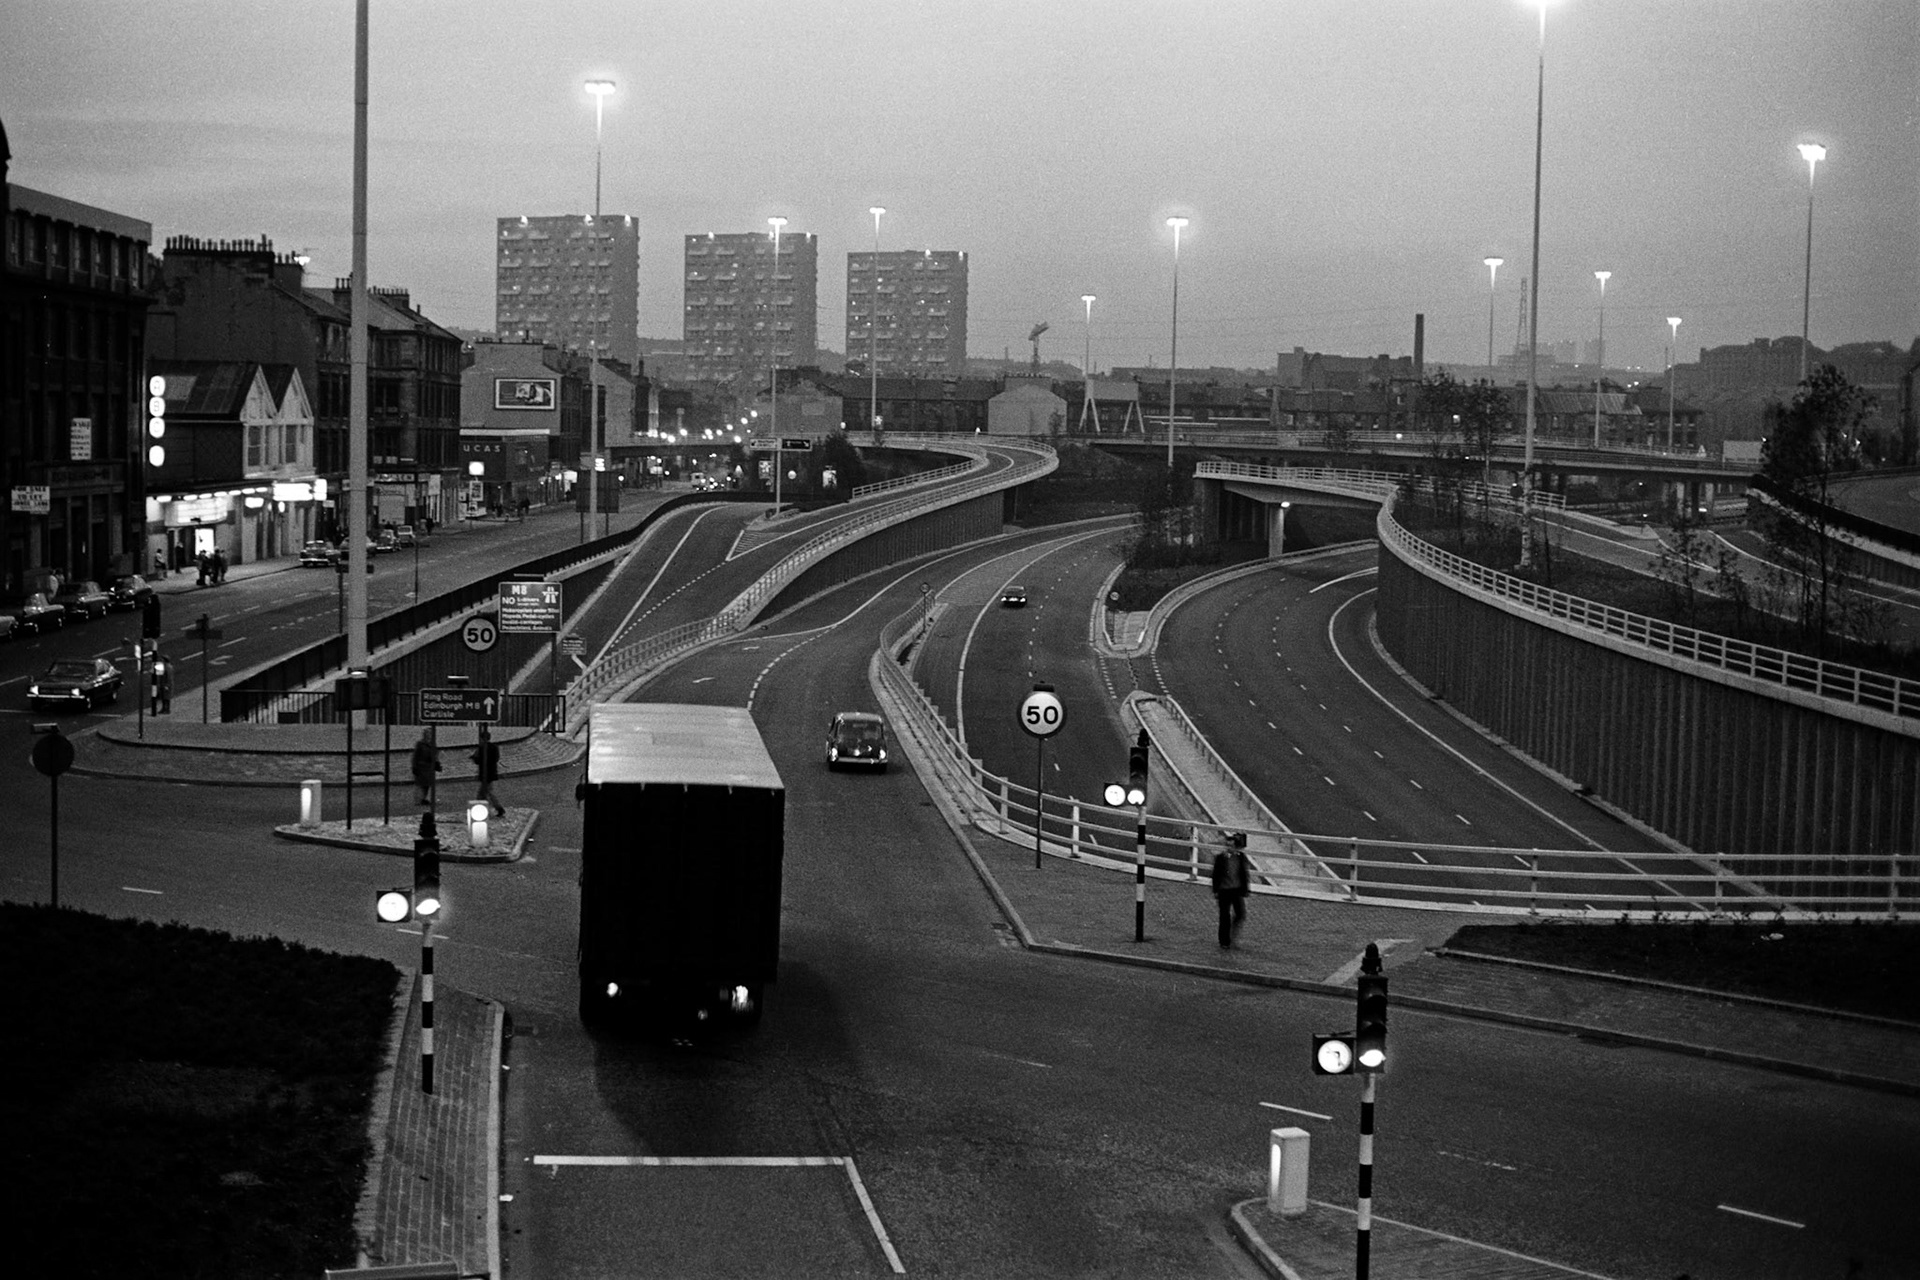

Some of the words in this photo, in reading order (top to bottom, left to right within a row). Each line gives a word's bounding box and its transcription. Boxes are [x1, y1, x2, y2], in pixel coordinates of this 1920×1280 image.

[502, 597, 516, 605] NO
[467, 627, 493, 643] 50
[423, 693, 442, 702] Ring
[442, 693, 464, 701] Road
[423, 701, 464, 711] Edinburgh
[423, 709, 456, 718] Carlisle
[1027, 706, 1059, 725] 50
